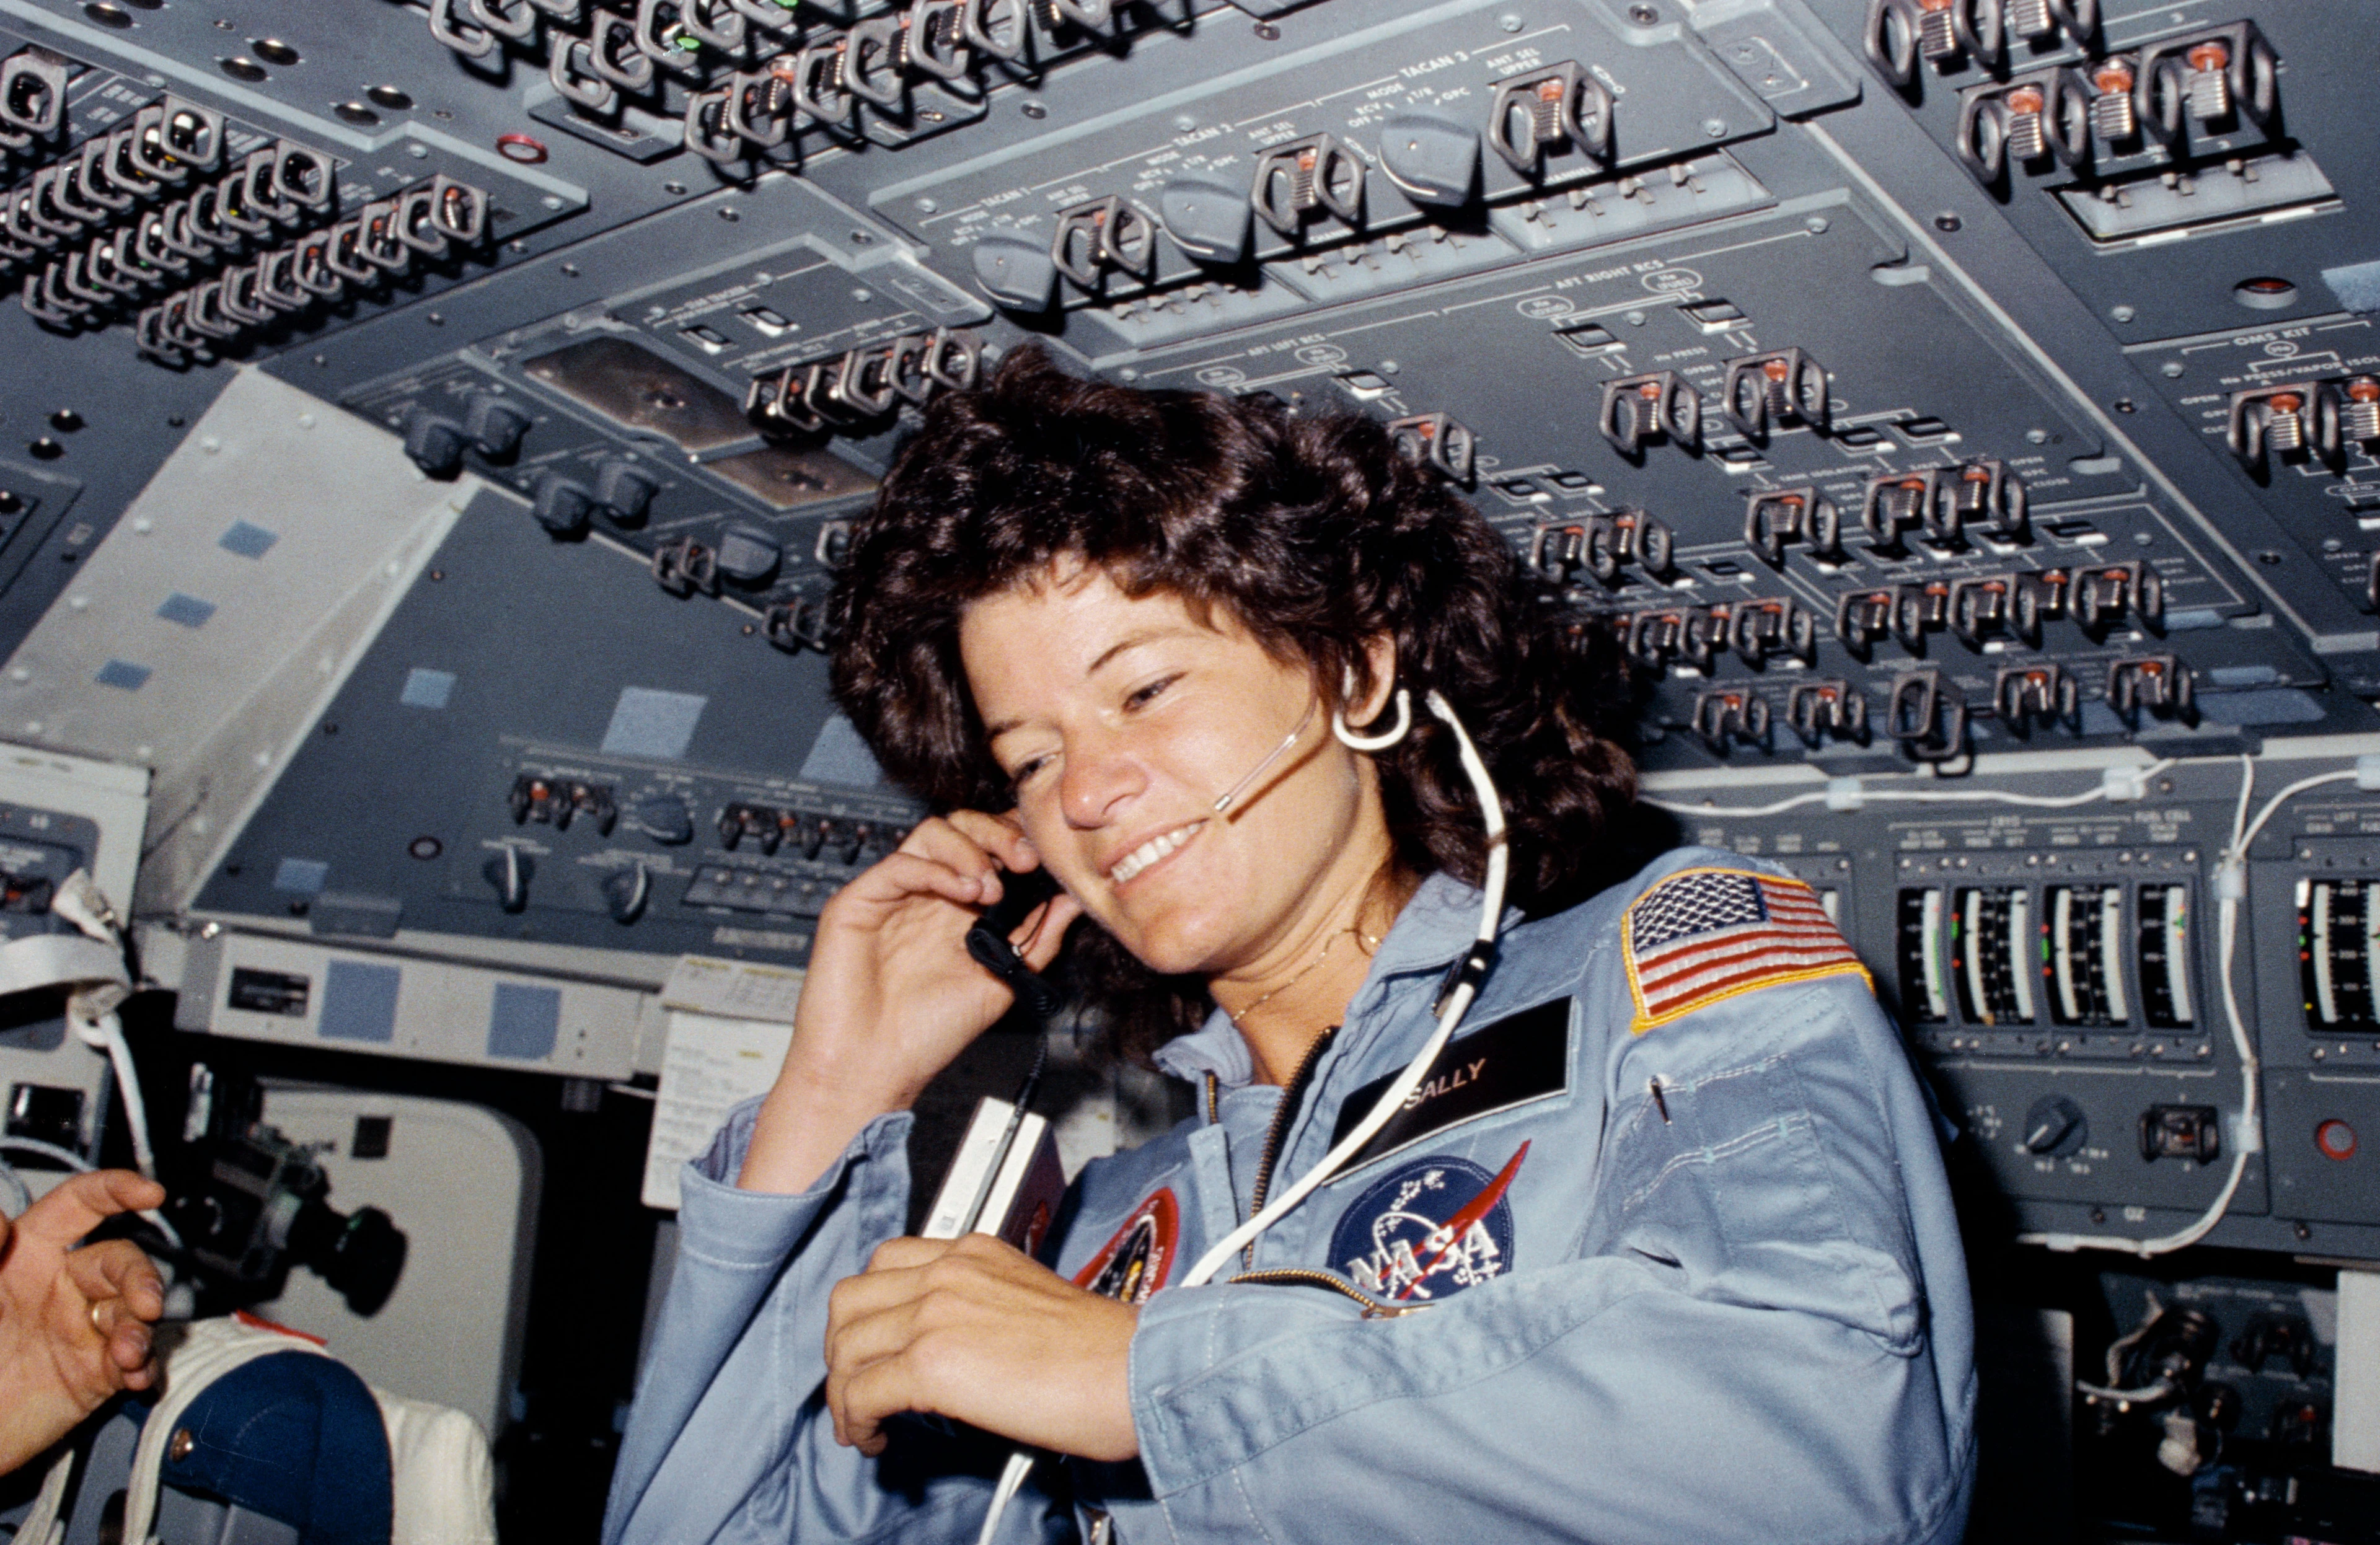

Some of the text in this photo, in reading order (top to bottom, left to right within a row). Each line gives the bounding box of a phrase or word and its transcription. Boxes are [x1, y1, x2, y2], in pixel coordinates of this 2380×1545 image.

[1399, 51, 1469, 78] TACAN 3
[1499, 58, 1542, 75] UPPER
[1367, 83, 1406, 99] MODE
[1442, 87, 1471, 100] GPC
[1355, 102, 1381, 115] RCV
[1348, 116, 1370, 128] OFF
[1173, 126, 1222, 147] TACAN
[1555, 259, 1665, 289] AFT RIGHT RCS
[2233, 327, 2311, 346] OMS KIT
[2033, 477, 2070, 488] CLOSE
[1403, 1058, 1486, 1110] SALLY
[1346, 1218, 1499, 1299] NASA
